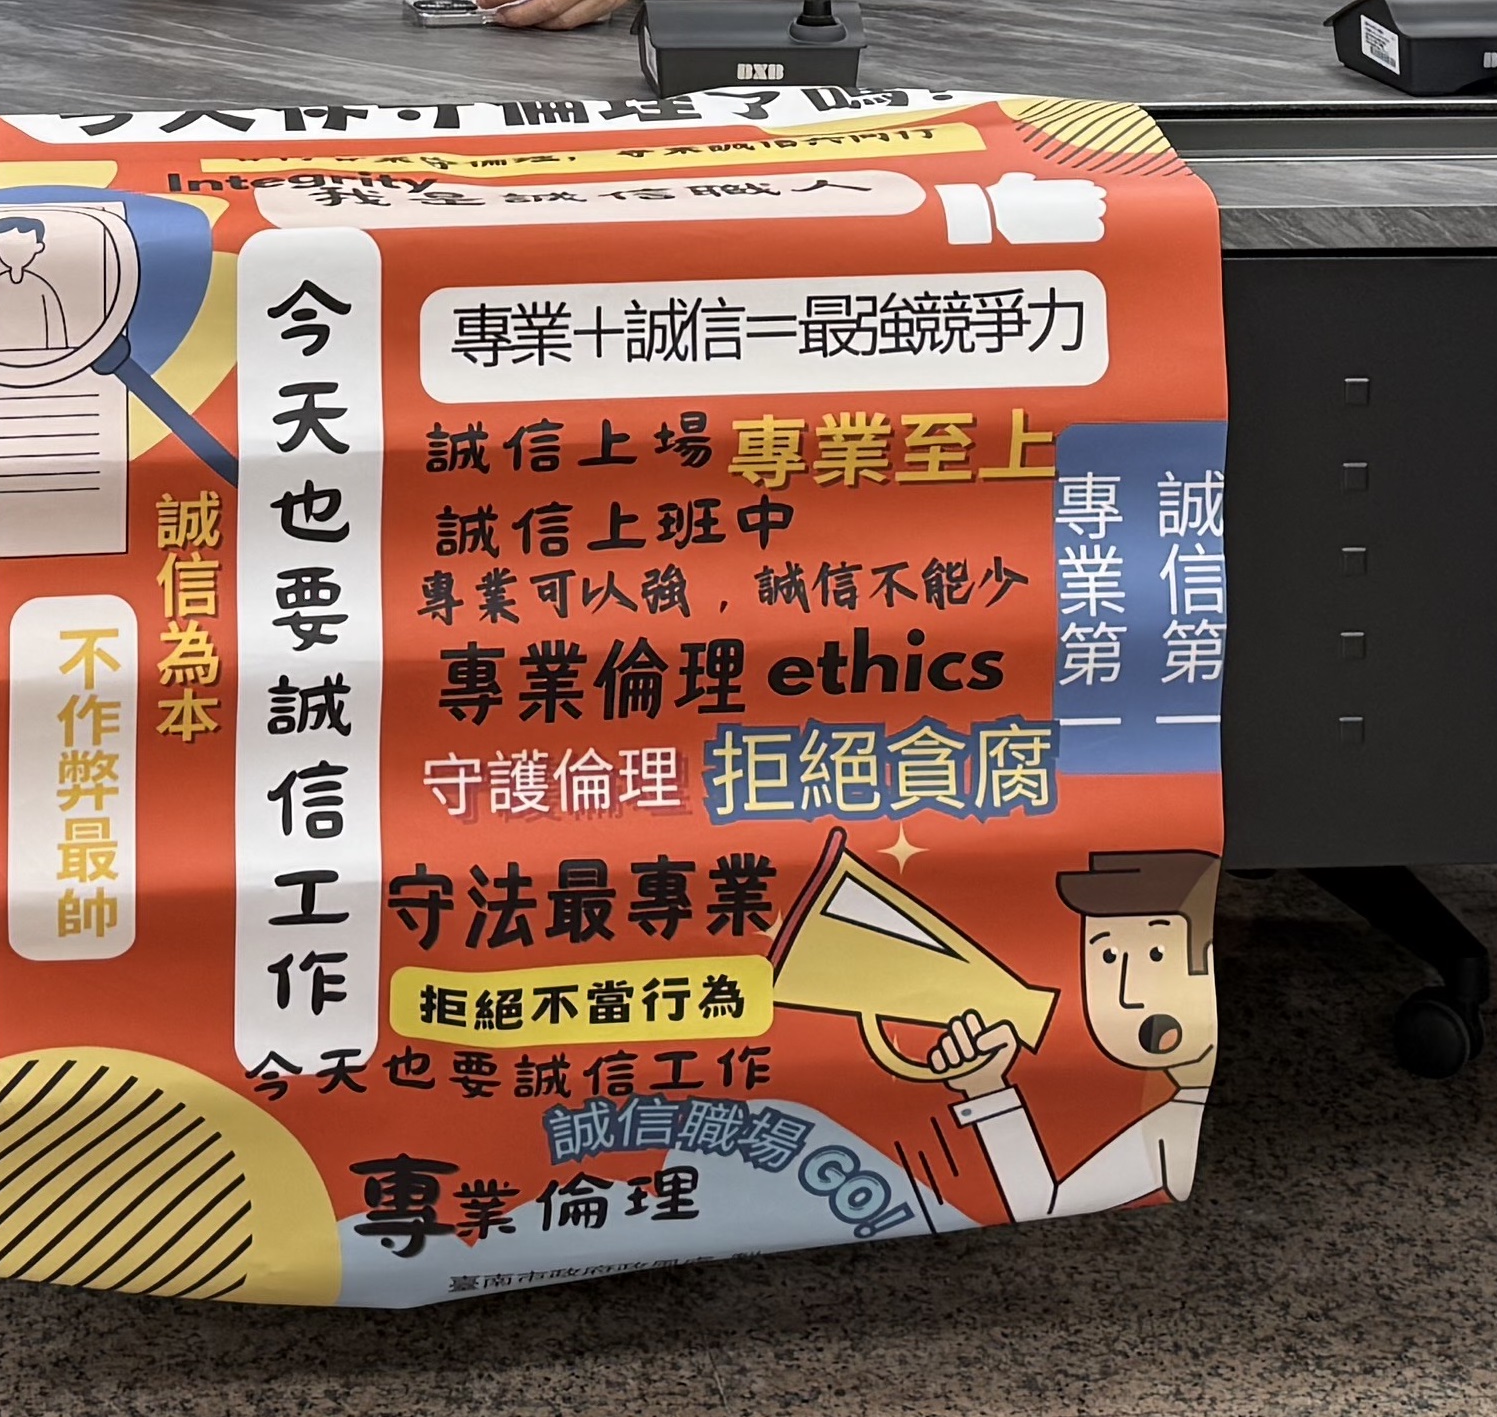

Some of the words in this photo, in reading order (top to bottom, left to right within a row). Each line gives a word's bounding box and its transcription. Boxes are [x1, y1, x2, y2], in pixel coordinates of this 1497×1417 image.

[736, 63, 785, 81] BXB
[167, 171, 438, 194] Integrity
[425, 411, 713, 476] 誠信上場
[727, 409, 1059, 487] 專業至上
[435, 494, 795, 559] 誠信上班中
[155, 490, 223, 743] 誠信為本
[266, 277, 353, 1016] 今天也要誠信工作
[1056, 474, 1128, 726] 專業第一
[1157, 470, 1227, 725] 誠信第一
[437, 638, 747, 726] 專業倫理
[768, 629, 1005, 697] ethics
[56, 627, 122, 939] 不作弊最帥
[422, 746, 679, 817] 守護倫理
[712, 721, 1053, 816] 拒絕貪腐
[387, 851, 778, 951] 守法最專業
[419, 972, 746, 1032] 拒絕不當行為
[245, 1044, 773, 1101] 今天也要誠信工作
[348, 1152, 701, 1258] 專業倫理
[548, 1097, 808, 1169] 誠信職場
[798, 1145, 916, 1238] GO!
